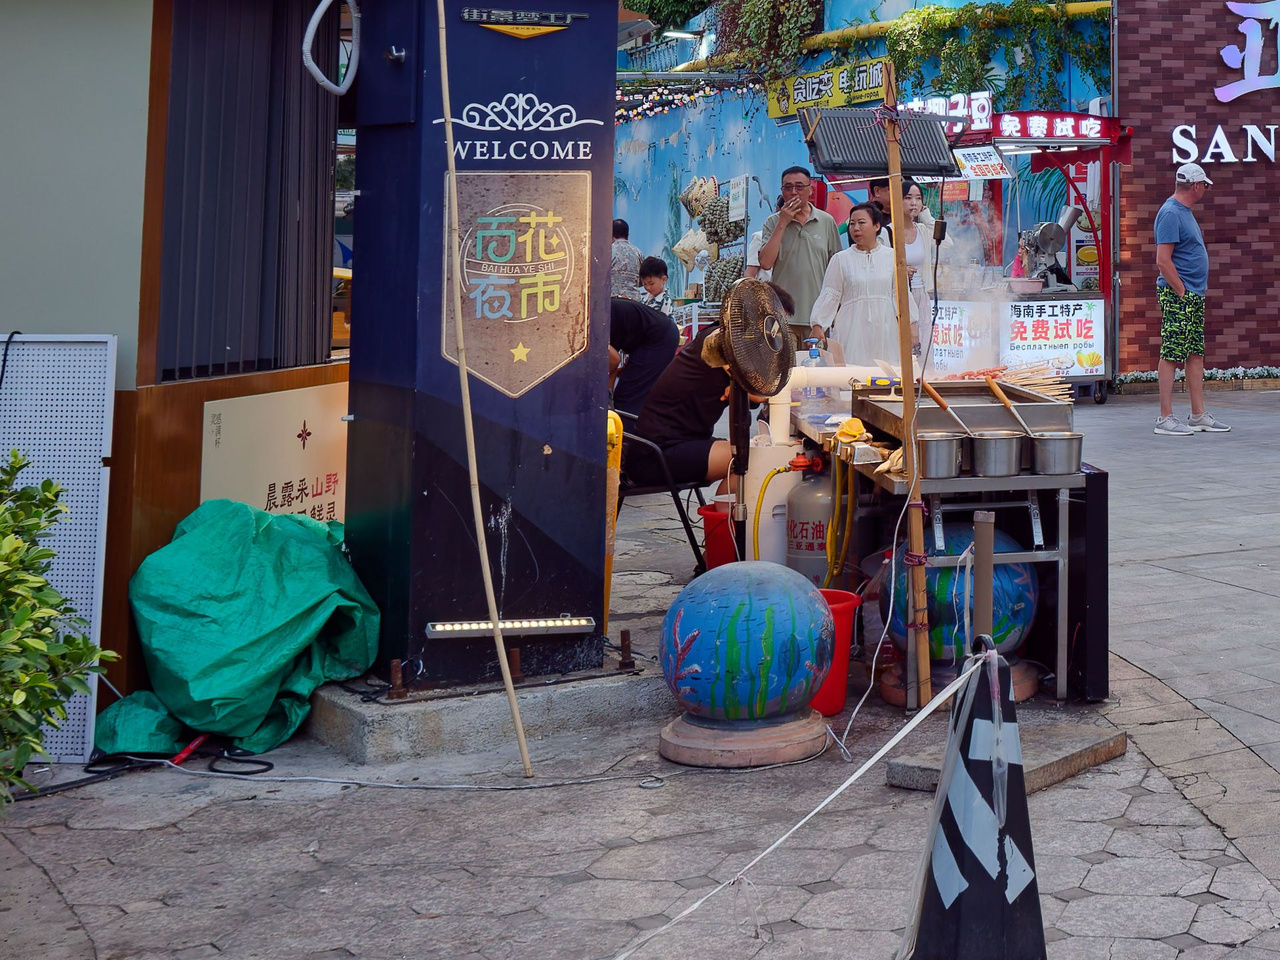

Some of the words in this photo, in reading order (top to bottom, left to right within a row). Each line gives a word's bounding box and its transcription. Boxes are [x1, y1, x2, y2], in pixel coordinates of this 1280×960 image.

[1000, 114, 1102, 138] 免费试吃
[445, 140, 593, 160] WELCOME
[1171, 125, 1279, 164] SAN
[475, 211, 566, 263] 百花
[481, 264, 498, 273] BAI
[500, 266, 521, 274] HUA
[522, 266, 536, 274] YE
[537, 263, 555, 272] SHI
[469, 273, 563, 319] 夜市
[1010, 304, 1083, 318] 海南手工特产
[1009, 318, 1094, 342] 免费试吃
[264, 472, 339, 511] 晨露采山野
[788, 520, 829, 540] 化石油
